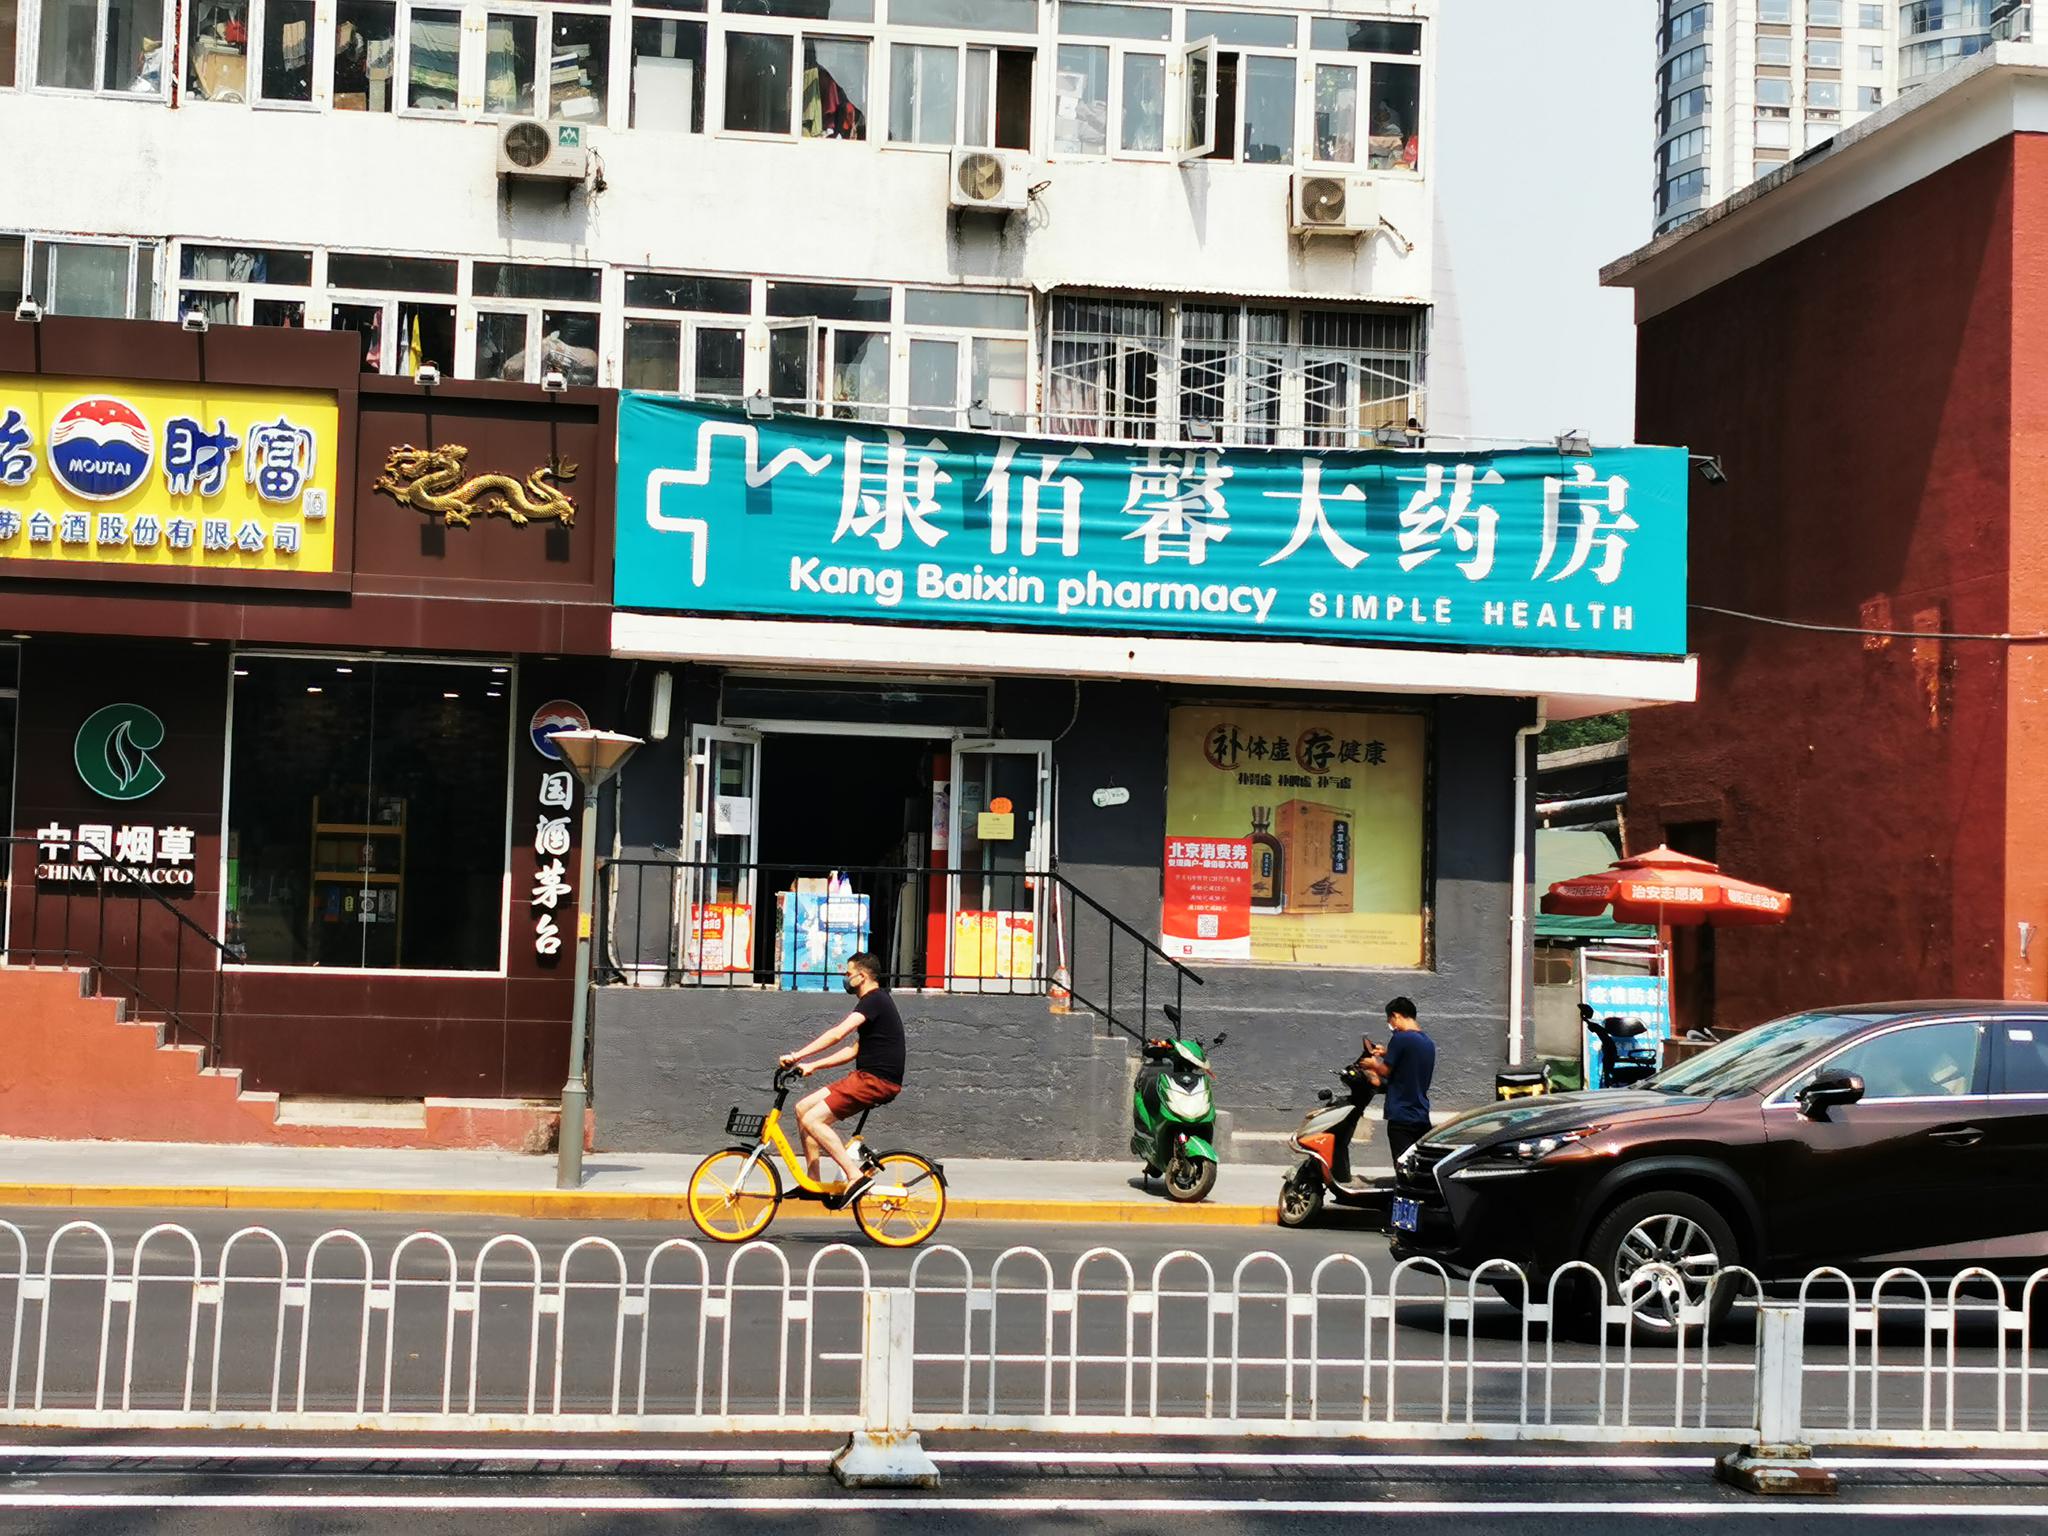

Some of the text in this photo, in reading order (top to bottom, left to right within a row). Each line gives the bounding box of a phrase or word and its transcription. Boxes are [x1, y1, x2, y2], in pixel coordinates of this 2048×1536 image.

[68, 456, 132, 477] MOUTAI
[832, 427, 1640, 585] 康佰馨大药房
[789, 555, 1635, 631] Kang Baixin pharmacy SIMPLE HEALTH
[37, 821, 196, 866] 中国烟草
[531, 771, 574, 955] 国酒茅台
[1168, 842, 1248, 860] 北京消费券
[35, 863, 97, 882] CHINA
